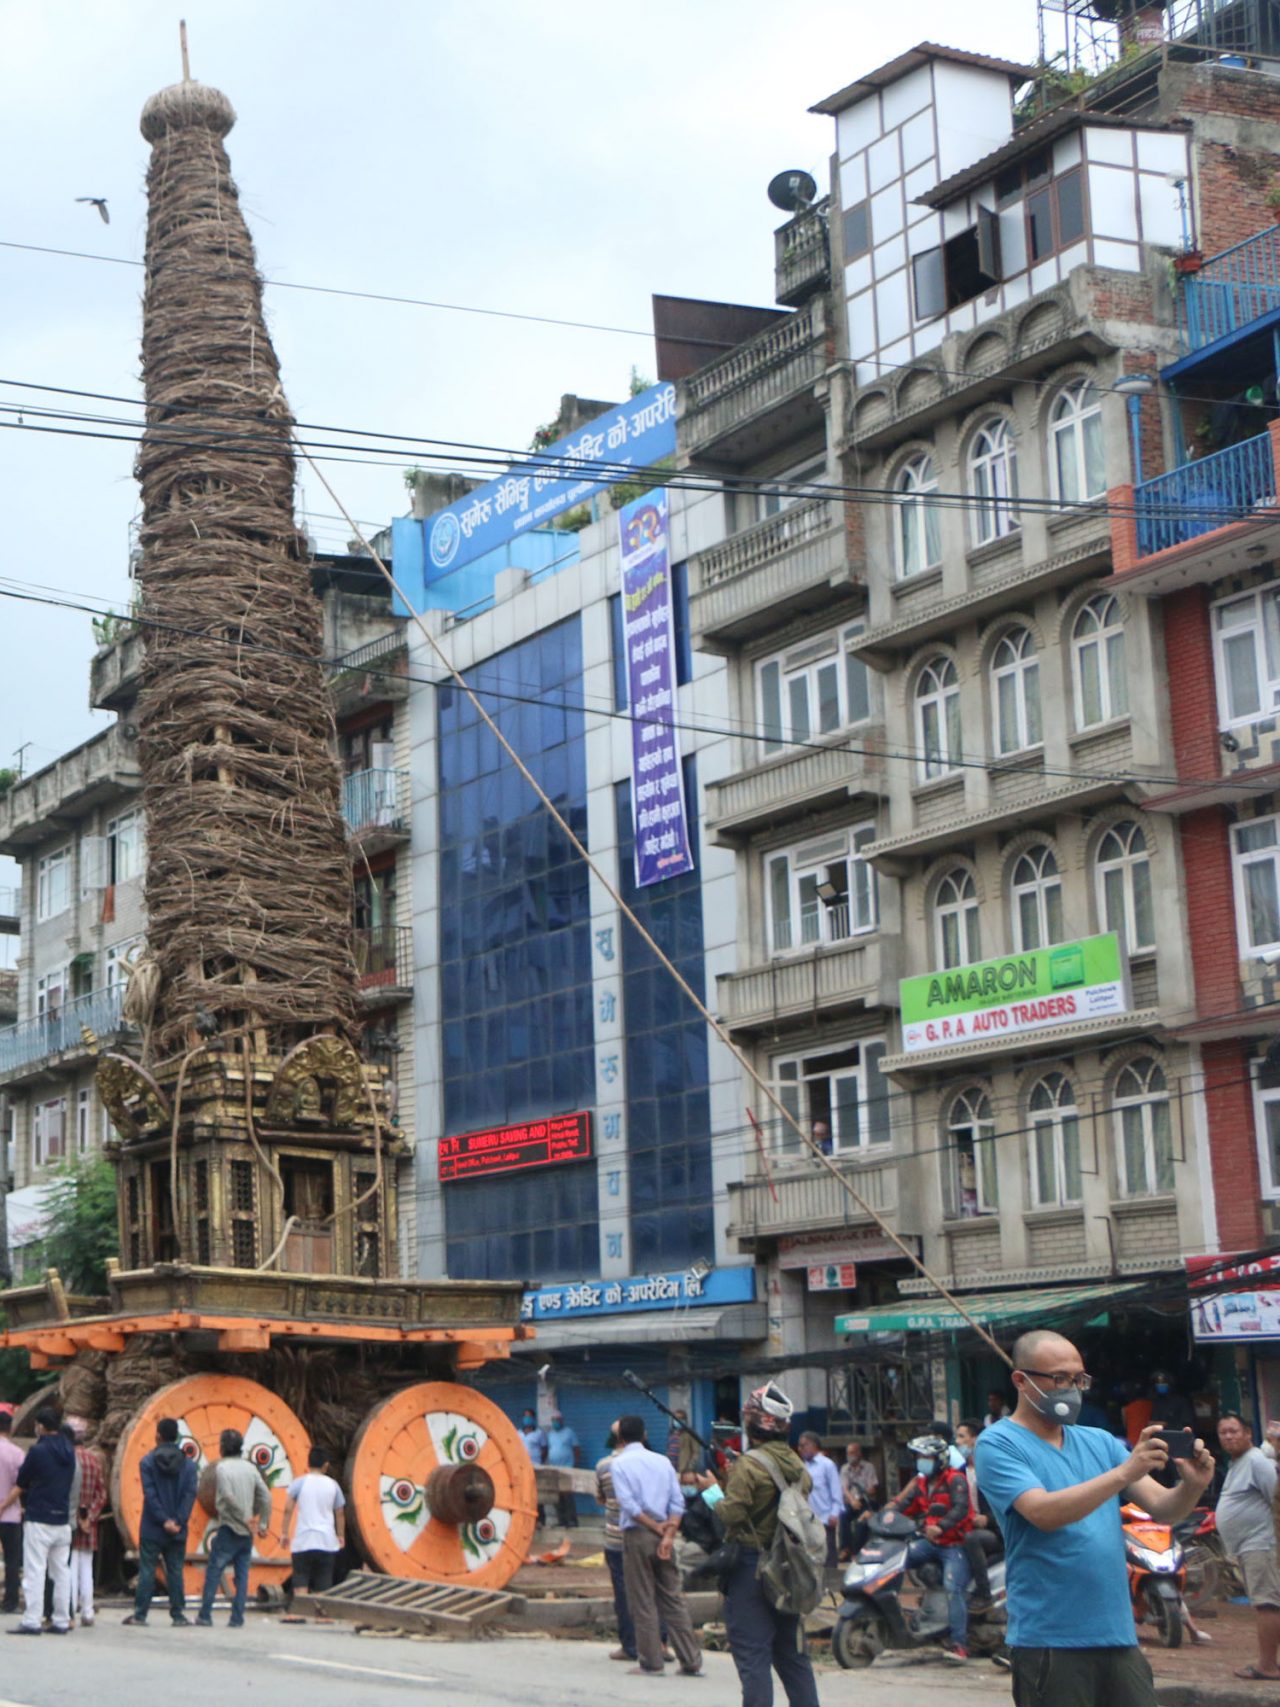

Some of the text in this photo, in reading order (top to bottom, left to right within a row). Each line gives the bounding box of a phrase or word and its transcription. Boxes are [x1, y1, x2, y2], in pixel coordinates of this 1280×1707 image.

[927, 957, 1037, 1007] AMARON
[972, 1010, 1009, 1033] AUTO
[1011, 994, 1078, 1025] TRADERS
[529, 1124, 546, 1140] AND
[538, 1291, 562, 1311] एण्ड
[566, 1285, 602, 1310] क्रेडिट
